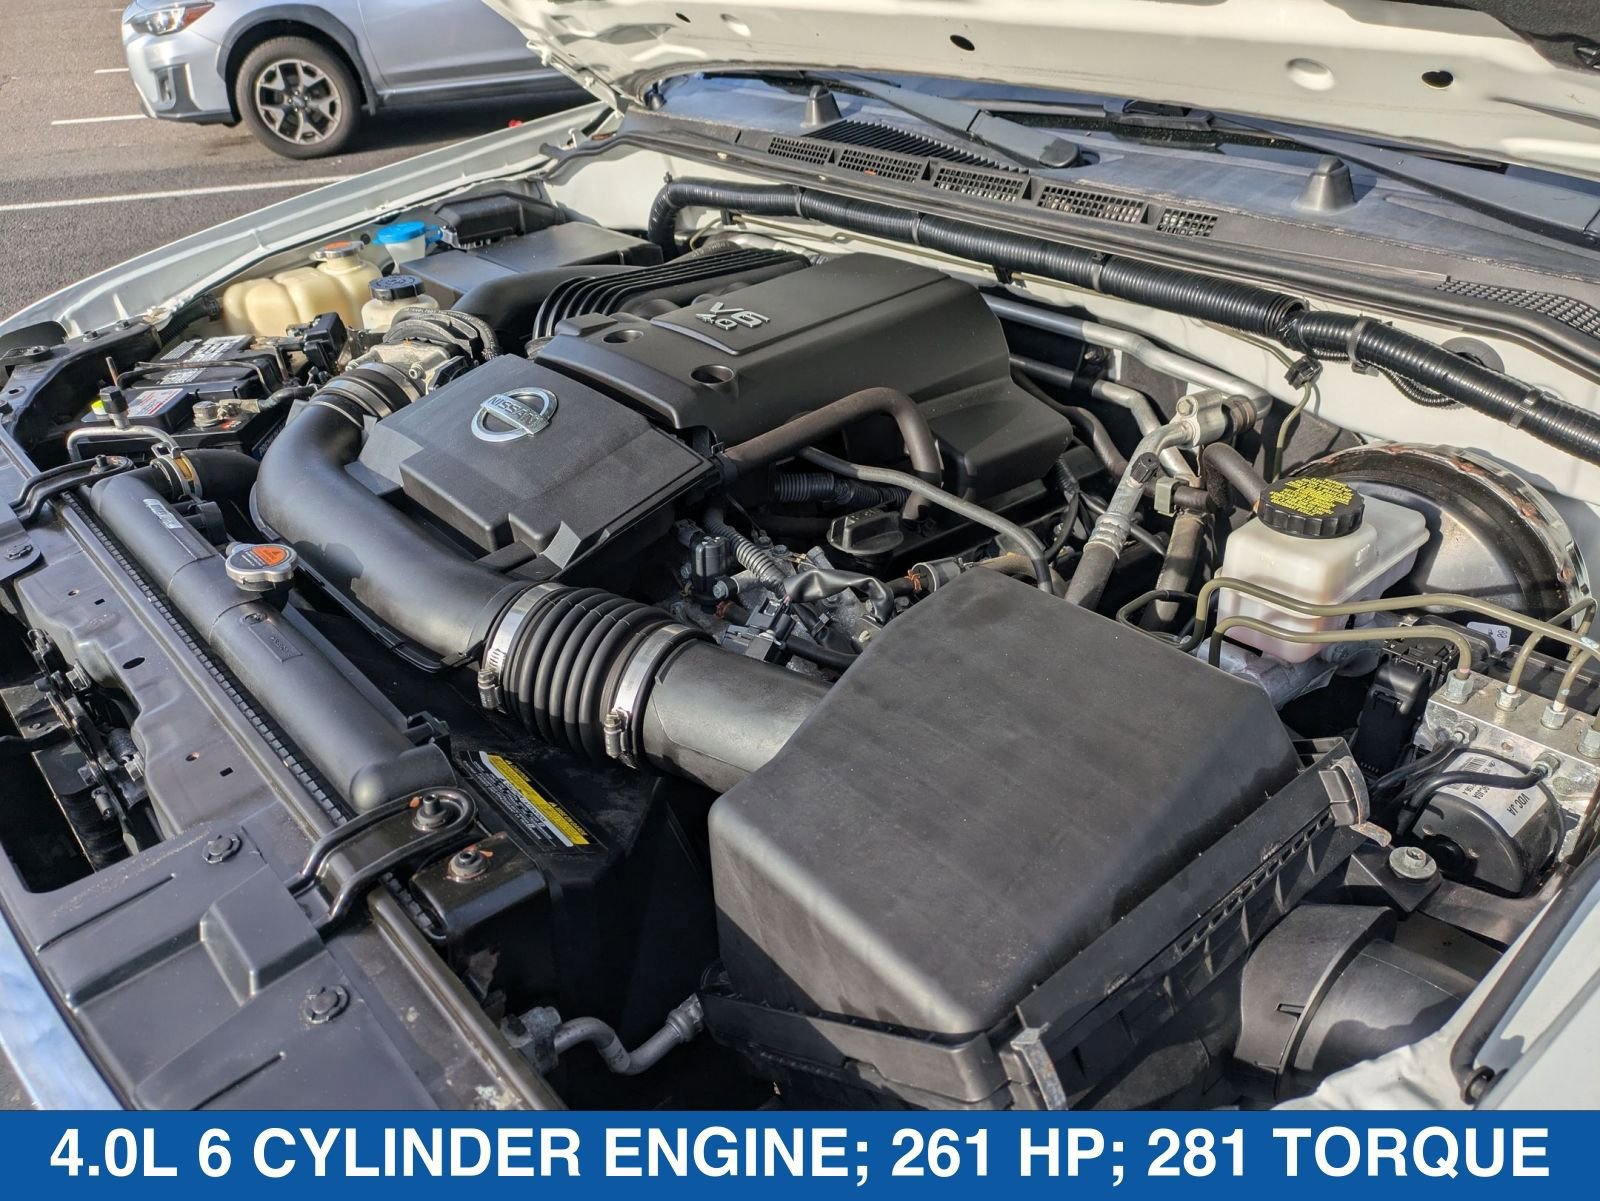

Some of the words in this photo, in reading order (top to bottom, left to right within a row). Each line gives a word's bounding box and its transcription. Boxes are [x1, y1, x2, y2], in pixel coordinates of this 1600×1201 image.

[709, 302, 771, 328] V6
[488, 396, 543, 428] NISSAN
[1506, 803, 1518, 816] JA
[1513, 792, 1531, 809] VDC
